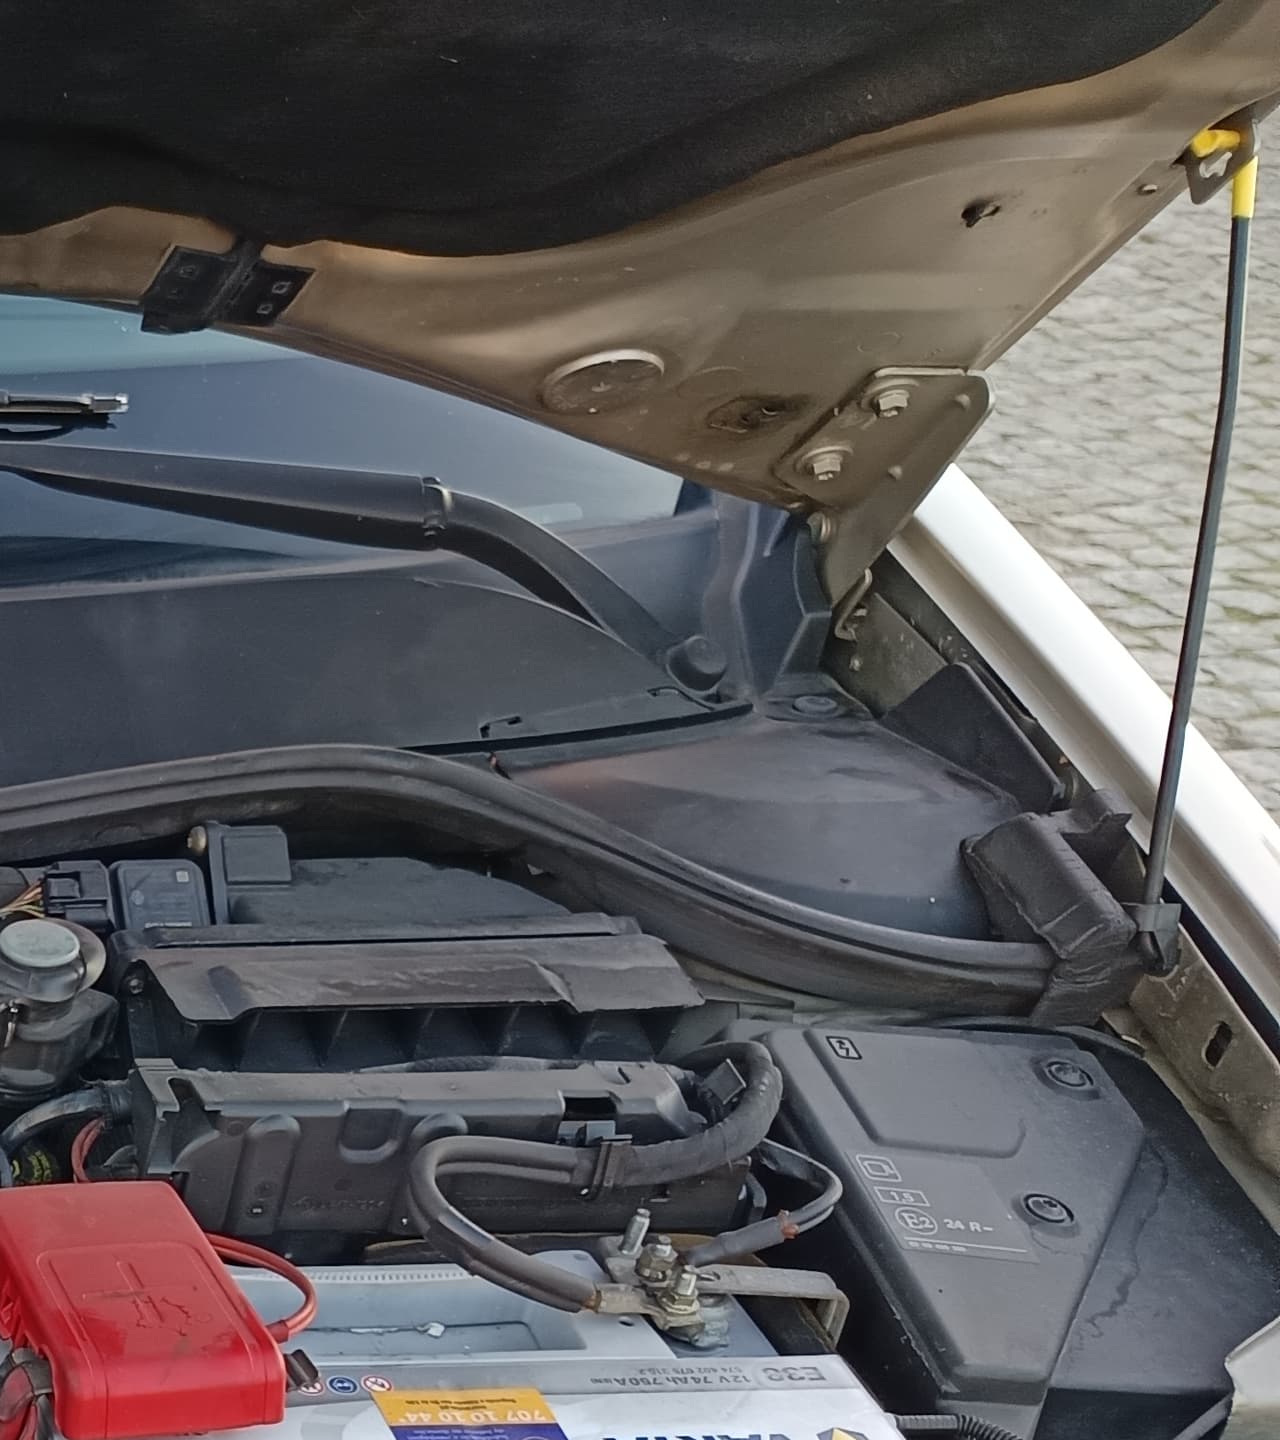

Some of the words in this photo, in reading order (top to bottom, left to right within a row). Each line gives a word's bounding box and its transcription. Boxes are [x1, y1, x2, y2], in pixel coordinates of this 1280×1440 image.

[902, 1213, 934, 1229] E2
[435, 1410, 463, 1422] 10
[471, 1410, 499, 1422] 10
[507, 1410, 544, 1422] 707
